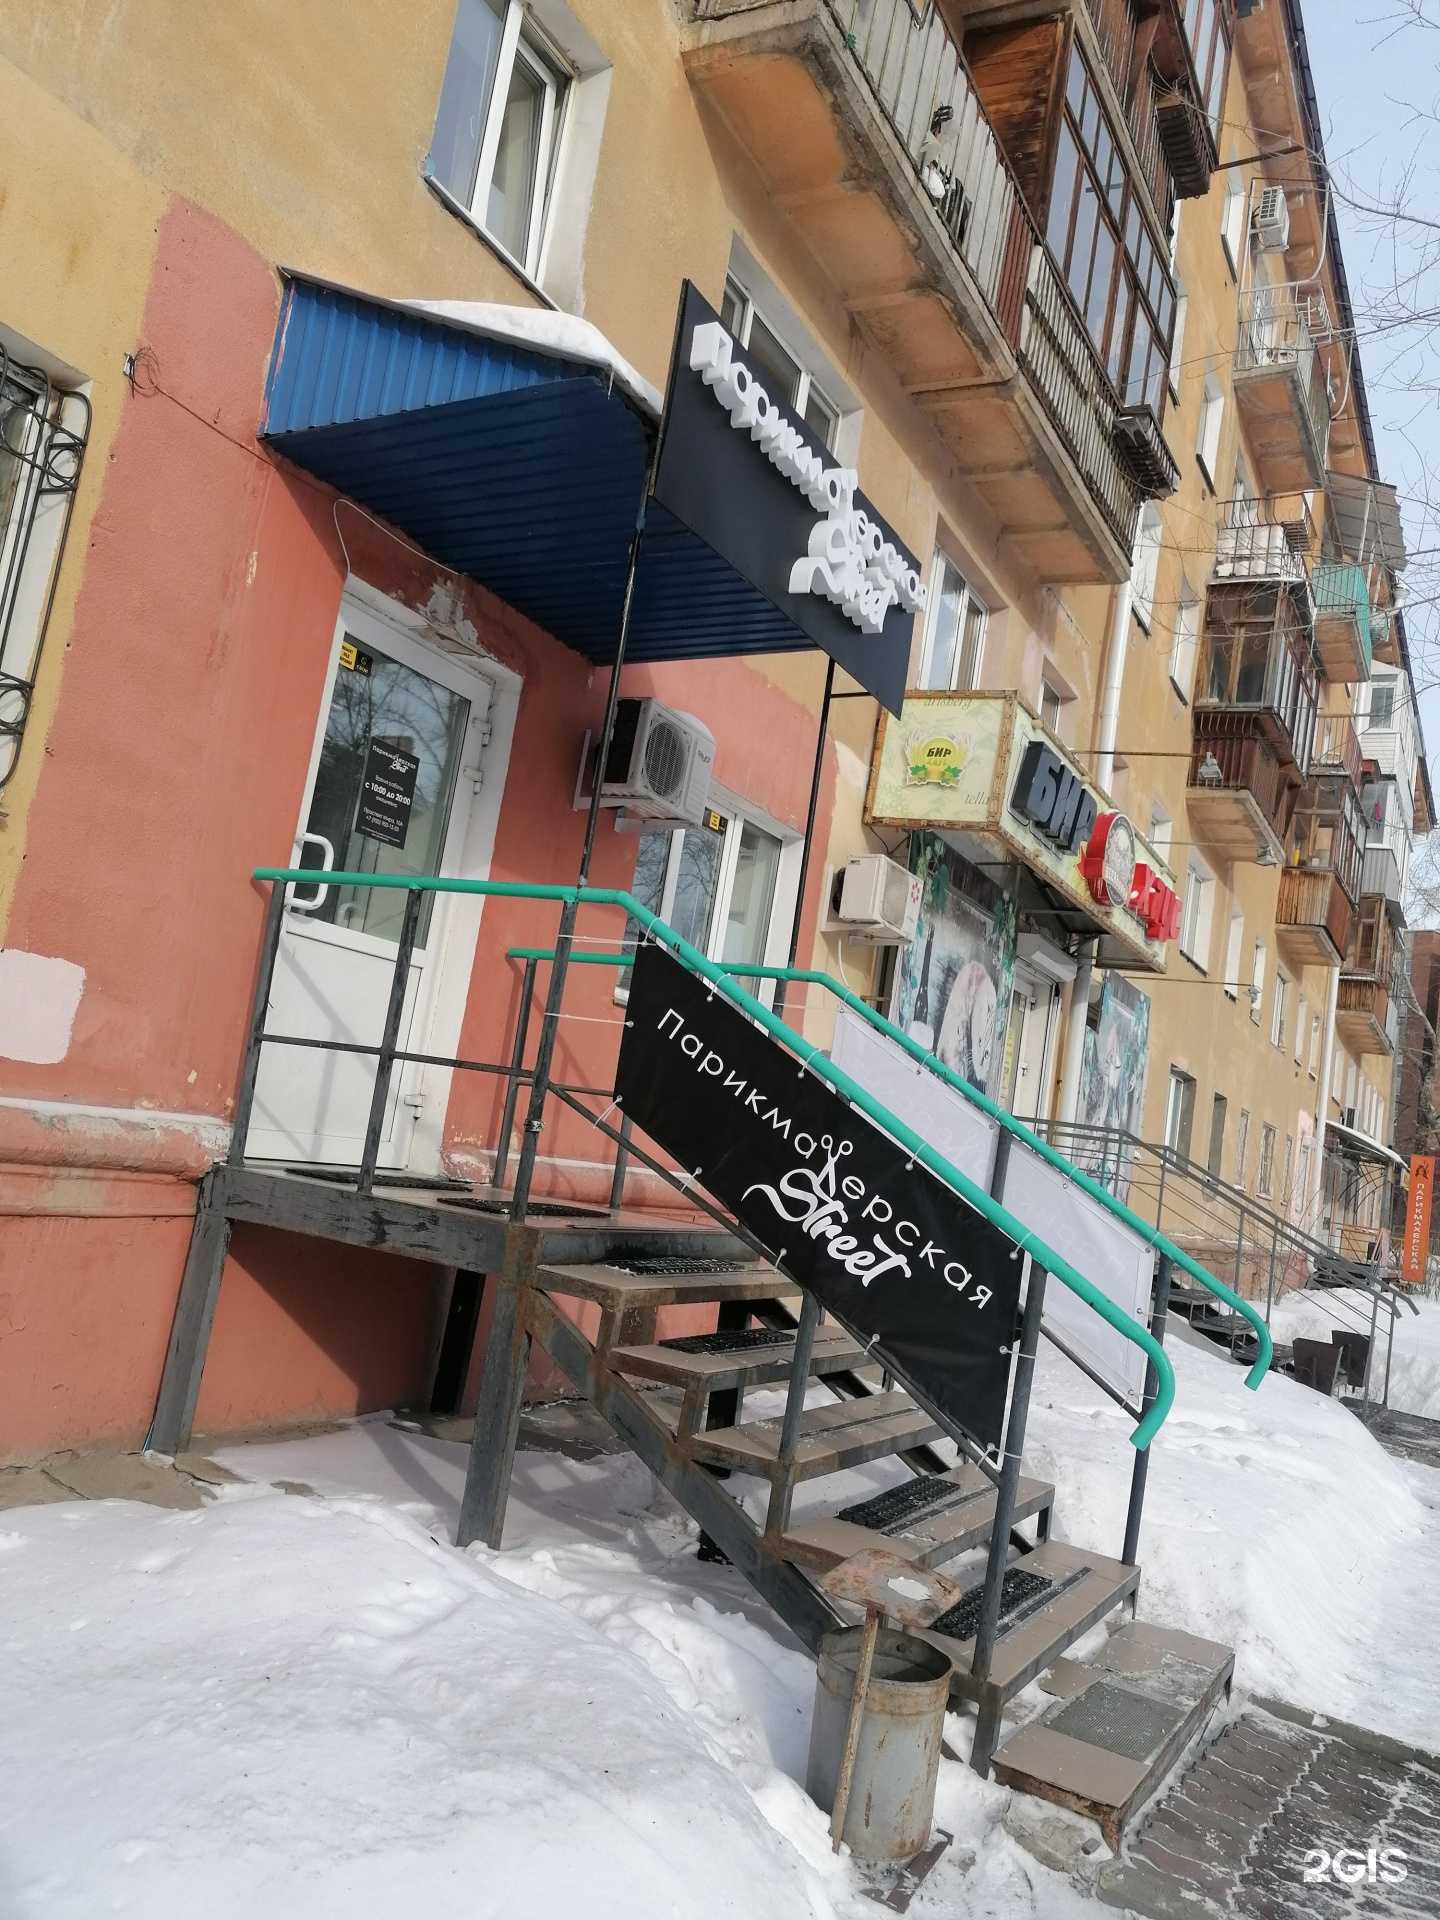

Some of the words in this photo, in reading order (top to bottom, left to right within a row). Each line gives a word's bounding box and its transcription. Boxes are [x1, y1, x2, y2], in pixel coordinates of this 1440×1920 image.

[927, 747, 952, 758] БИР
[371, 782, 387, 796] 10:00
[395, 794, 411, 805] 20:00
[1010, 741, 1097, 857] БИР
[741, 1168, 912, 1288] Street
